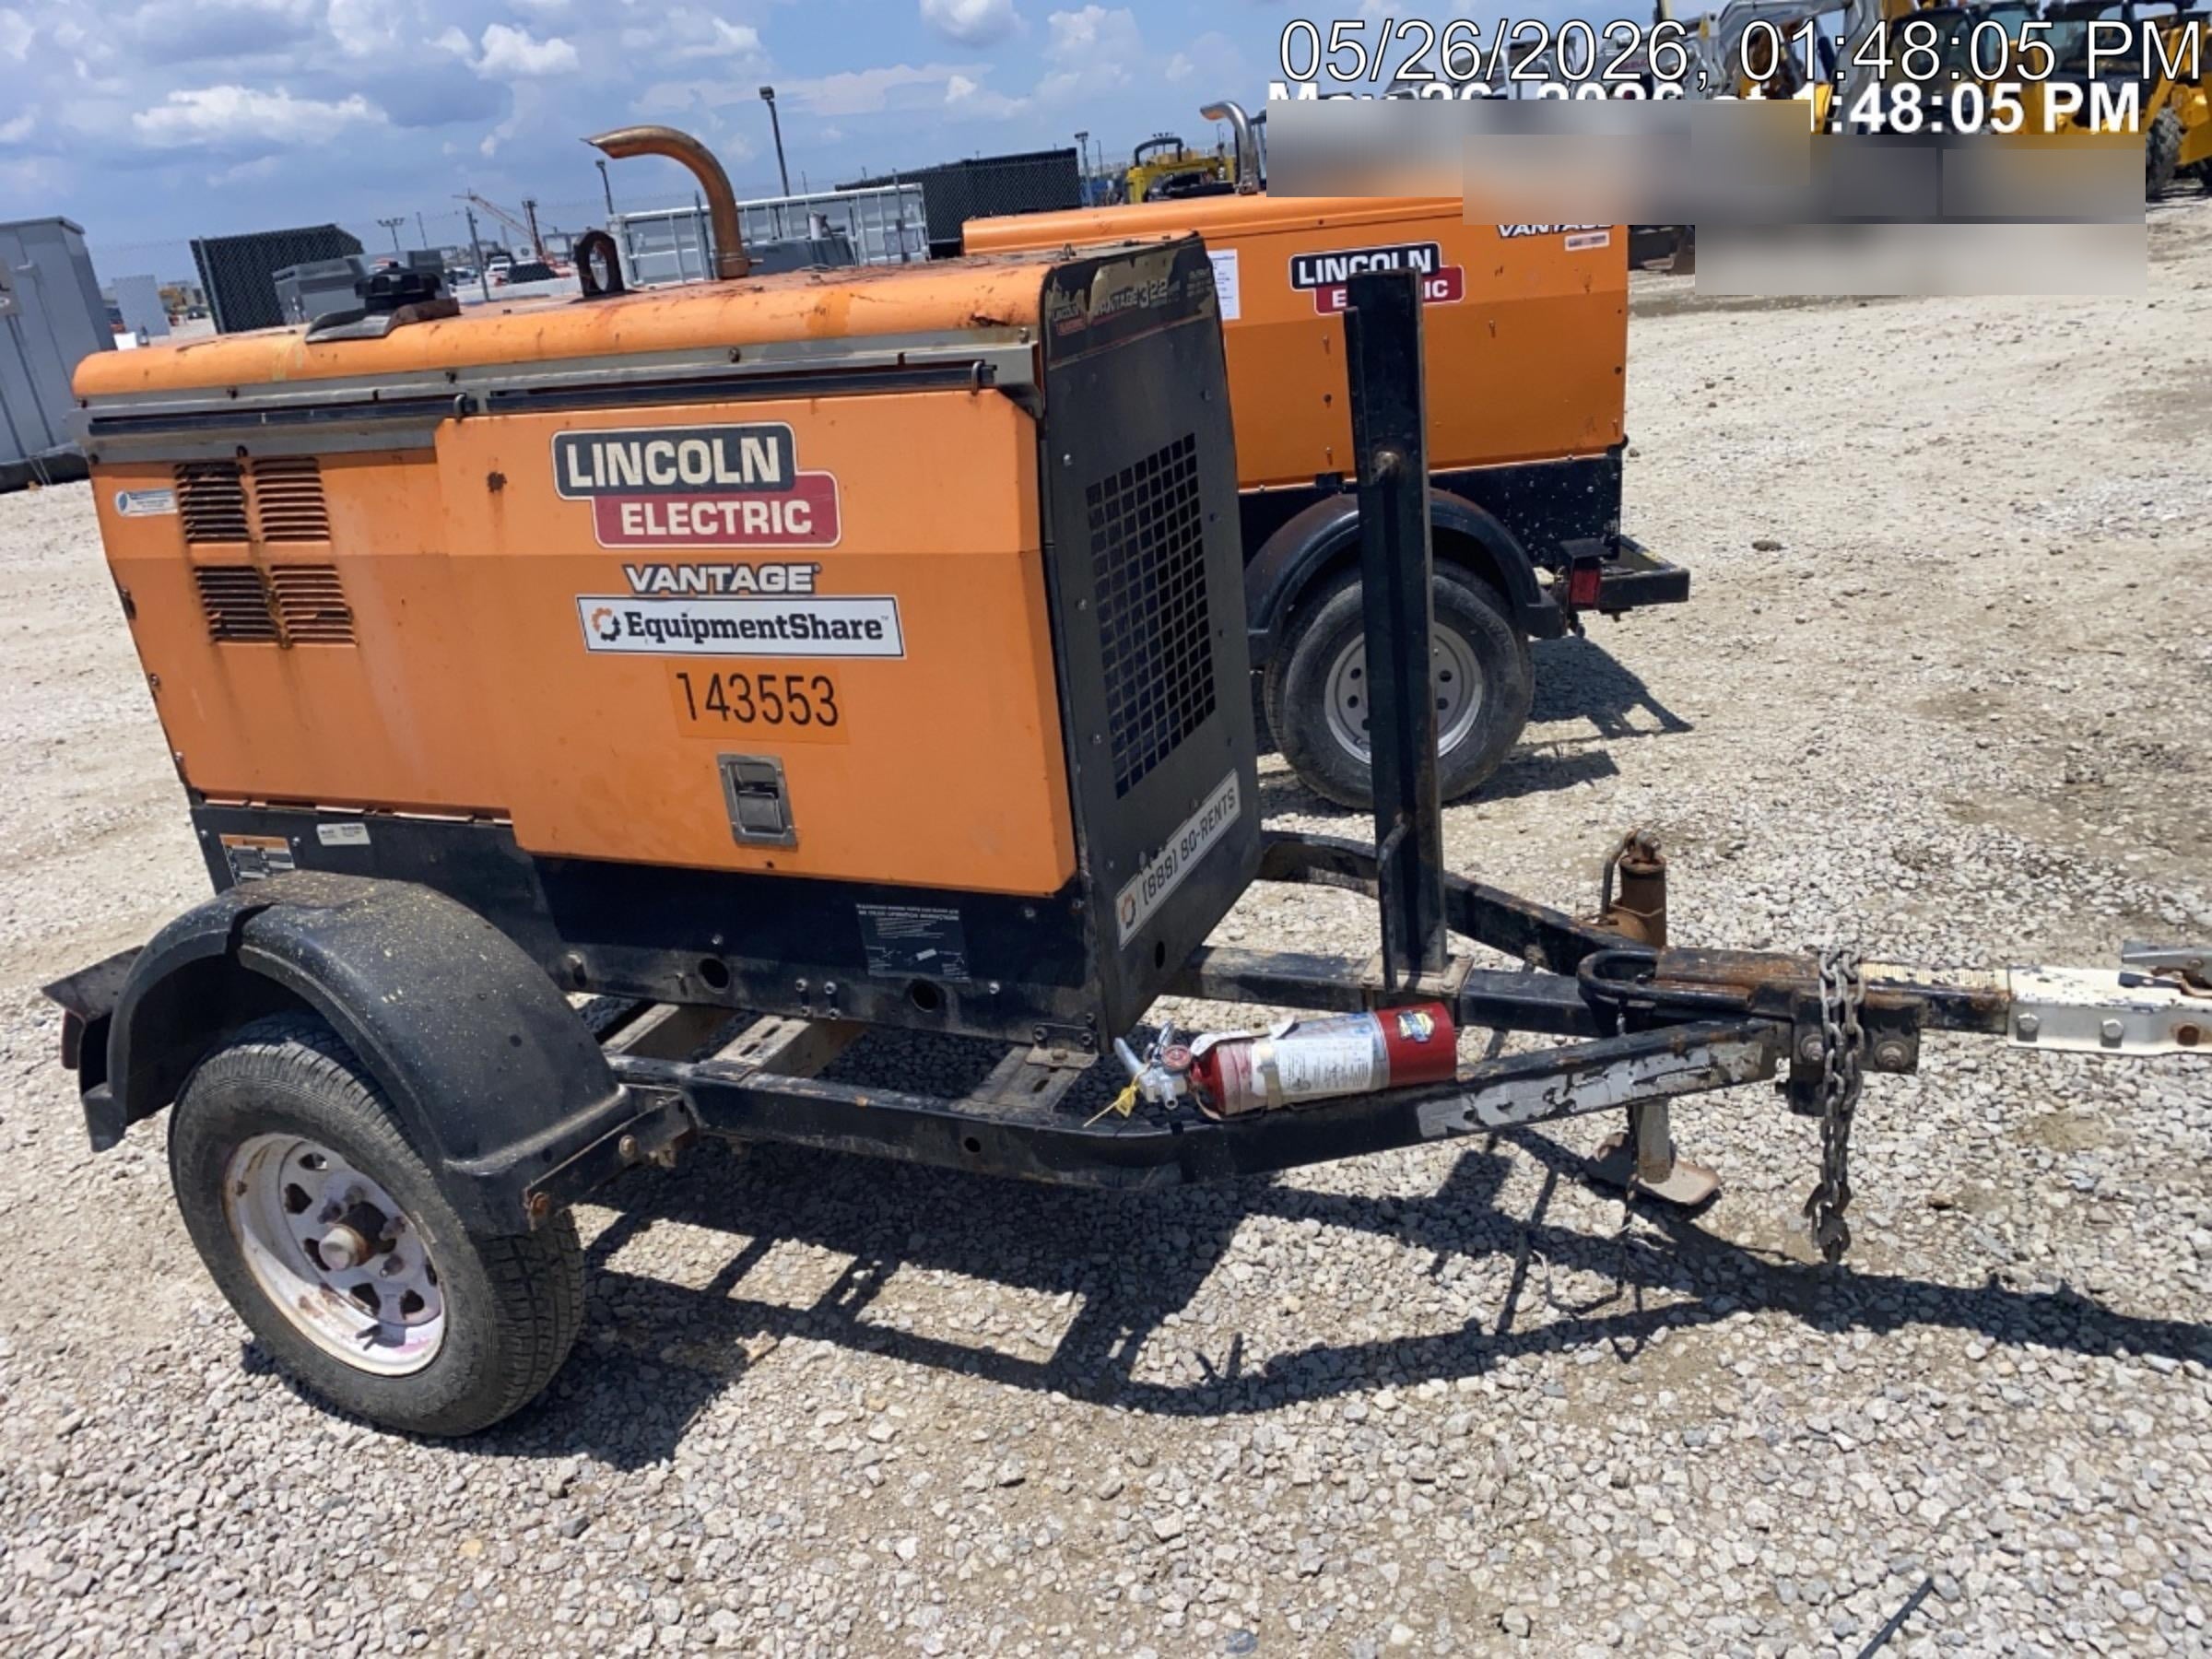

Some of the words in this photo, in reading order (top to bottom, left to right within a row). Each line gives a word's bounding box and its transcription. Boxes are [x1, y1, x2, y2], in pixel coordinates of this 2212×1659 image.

[566, 436, 782, 487] LINCOLN
[621, 500, 812, 535] ELECTRIC
[624, 610, 884, 644] EquipmentShare
[676, 671, 840, 727] 143553
